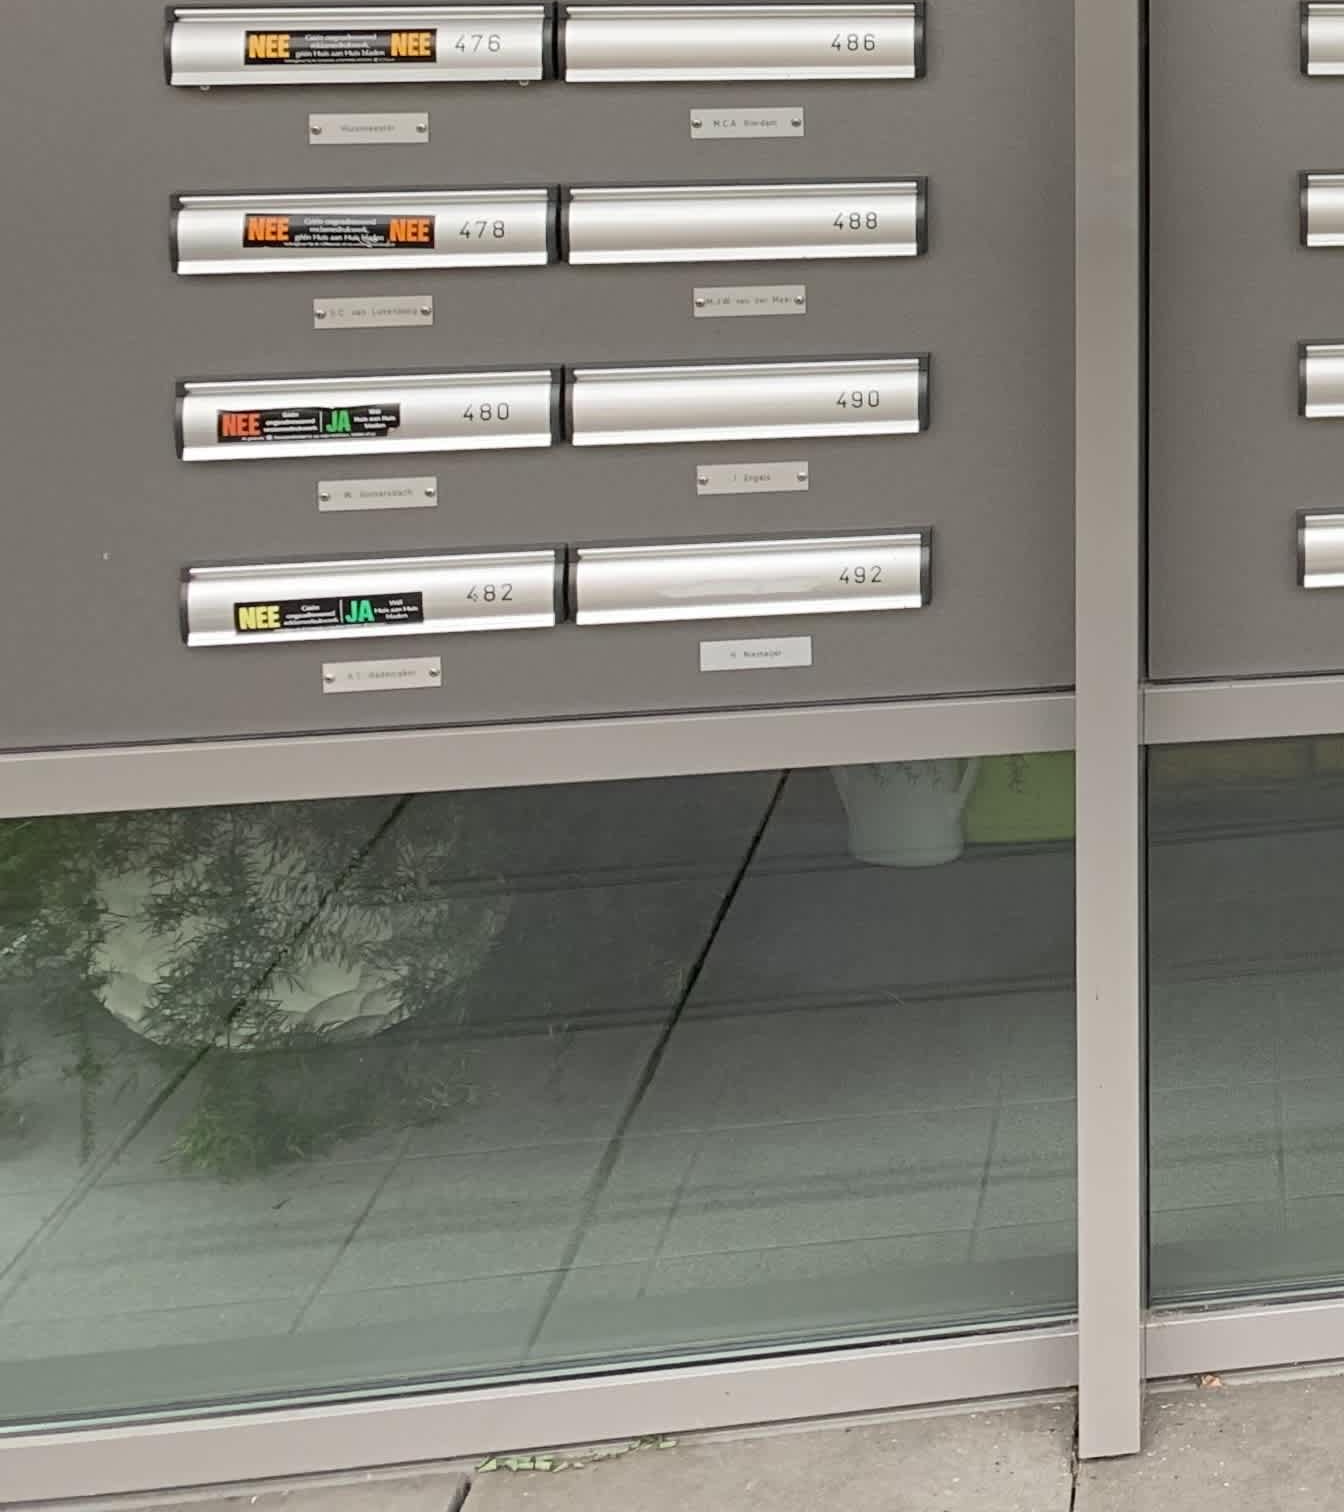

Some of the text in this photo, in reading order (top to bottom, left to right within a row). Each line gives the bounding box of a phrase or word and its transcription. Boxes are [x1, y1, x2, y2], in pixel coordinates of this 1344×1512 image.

[247, 35, 289, 58] NEE
[389, 33, 432, 56] NEE
[454, 33, 502, 53] 476
[831, 33, 876, 52] 486
[246, 216, 289, 240] NEE
[389, 219, 431, 242] NEE
[459, 220, 505, 240] 478
[833, 211, 878, 231] 488
[836, 390, 880, 410] 490
[326, 410, 351, 432] JA
[462, 402, 511, 422] 480
[222, 414, 262, 437] NEE
[839, 566, 882, 586] 492
[467, 582, 514, 603] 482
[239, 606, 281, 630] NEE
[345, 600, 374, 622] JA
